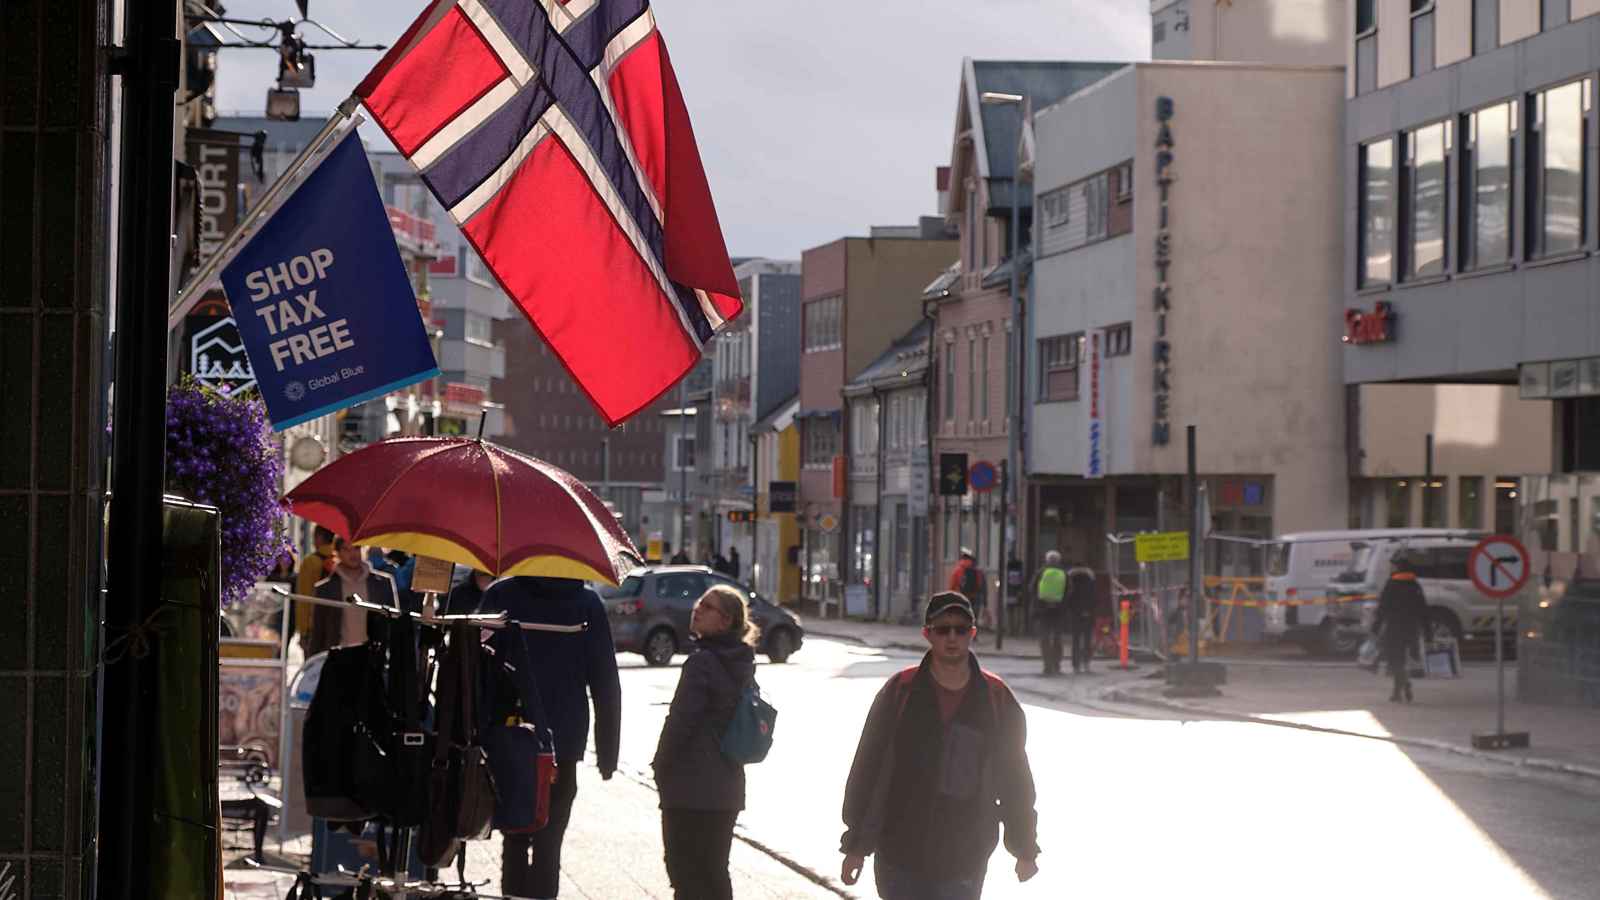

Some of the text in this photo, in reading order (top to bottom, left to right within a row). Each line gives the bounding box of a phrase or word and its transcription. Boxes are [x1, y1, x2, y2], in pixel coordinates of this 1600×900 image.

[245, 248, 335, 302] SHOP
[1154, 96, 1175, 446] BAPTISTKIRKEN
[255, 289, 328, 336] TAX
[268, 318, 356, 373] FREE
[307, 364, 366, 391] Global Blue
